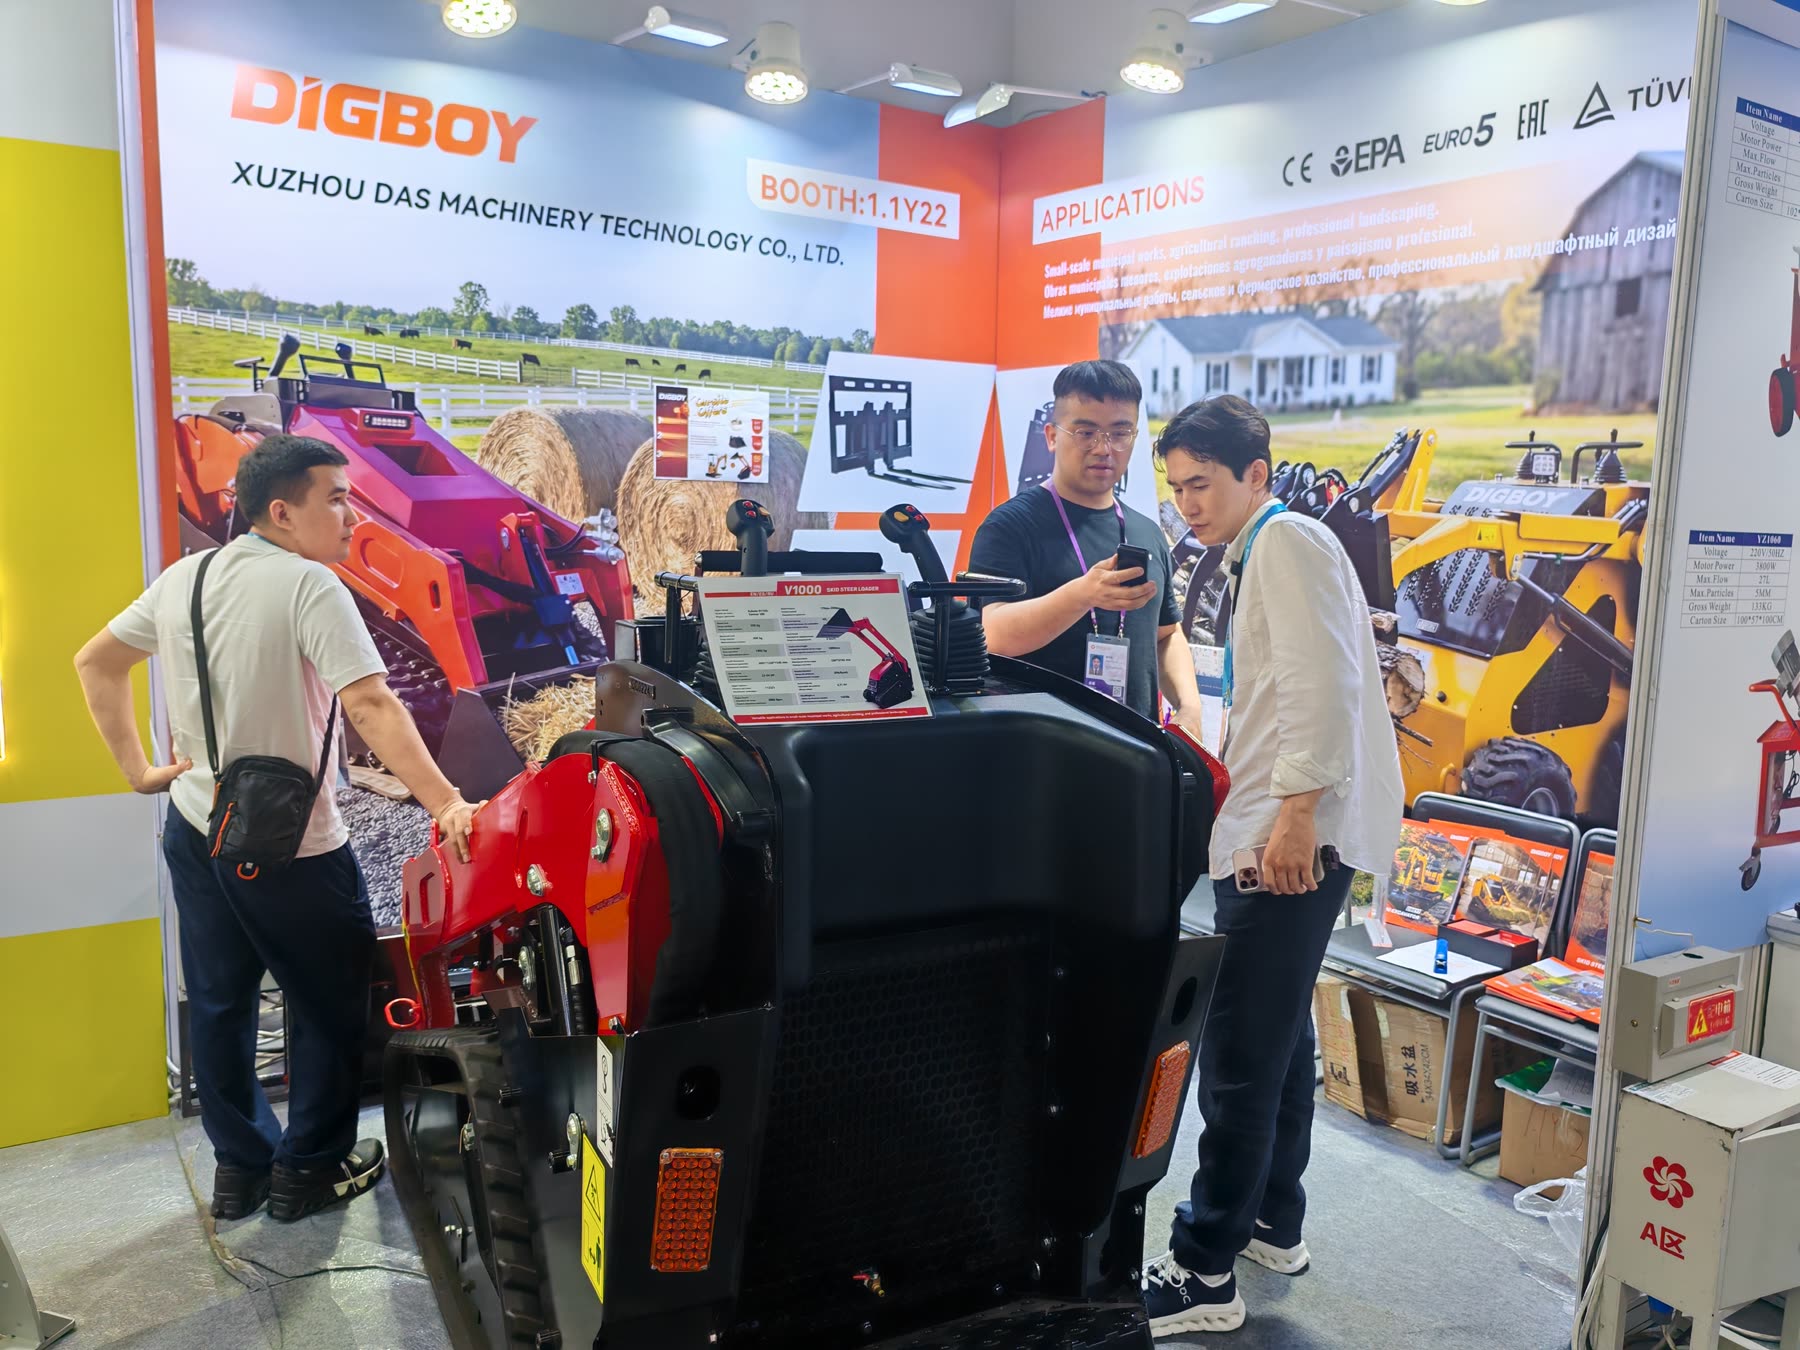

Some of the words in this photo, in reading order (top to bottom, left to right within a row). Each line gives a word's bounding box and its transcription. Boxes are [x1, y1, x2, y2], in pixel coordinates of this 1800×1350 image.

[1745, 102, 1762, 117] Item
[1763, 109, 1783, 123] Name
[1751, 119, 1775, 138] Voltage
[1740, 132, 1760, 147] Motor
[1762, 138, 1782, 153] Power
[1354, 133, 1406, 174] EPA
[1282, 151, 1314, 187] CE
[1734, 176, 1754, 190] Gross
[1755, 181, 1778, 199] Weight
[760, 173, 948, 229] BOOTH:1.1Y22
[1040, 176, 1206, 233] APPLICATIONS
[1735, 192, 1758, 206] Carton
[1760, 198, 1774, 211] Size
[232, 161, 365, 200] XUZHOU
[374, 182, 432, 210] DAS
[439, 190, 594, 232] MACHINERY
[600, 213, 753, 254] TECHNOLOGY
[803, 242, 844, 266] LTD.
[1044, 258, 1091, 279] Small-scale
[1228, 284, 1235, 295] и
[1463, 486, 1569, 508] DIGBOY
[1698, 532, 1715, 543] Item
[1716, 533, 1736, 543] Name
[1704, 546, 1728, 559] Voltage
[1693, 560, 1714, 570] Motor
[1715, 561, 1735, 570] Power
[784, 585, 822, 595] V1000
[1688, 602, 1708, 611] Gross
[1709, 602, 1731, 613] Weight
[1690, 615, 1712, 625] Carton
[1713, 615, 1727, 625] Size
[1640, 1221, 1686, 1260] A区
